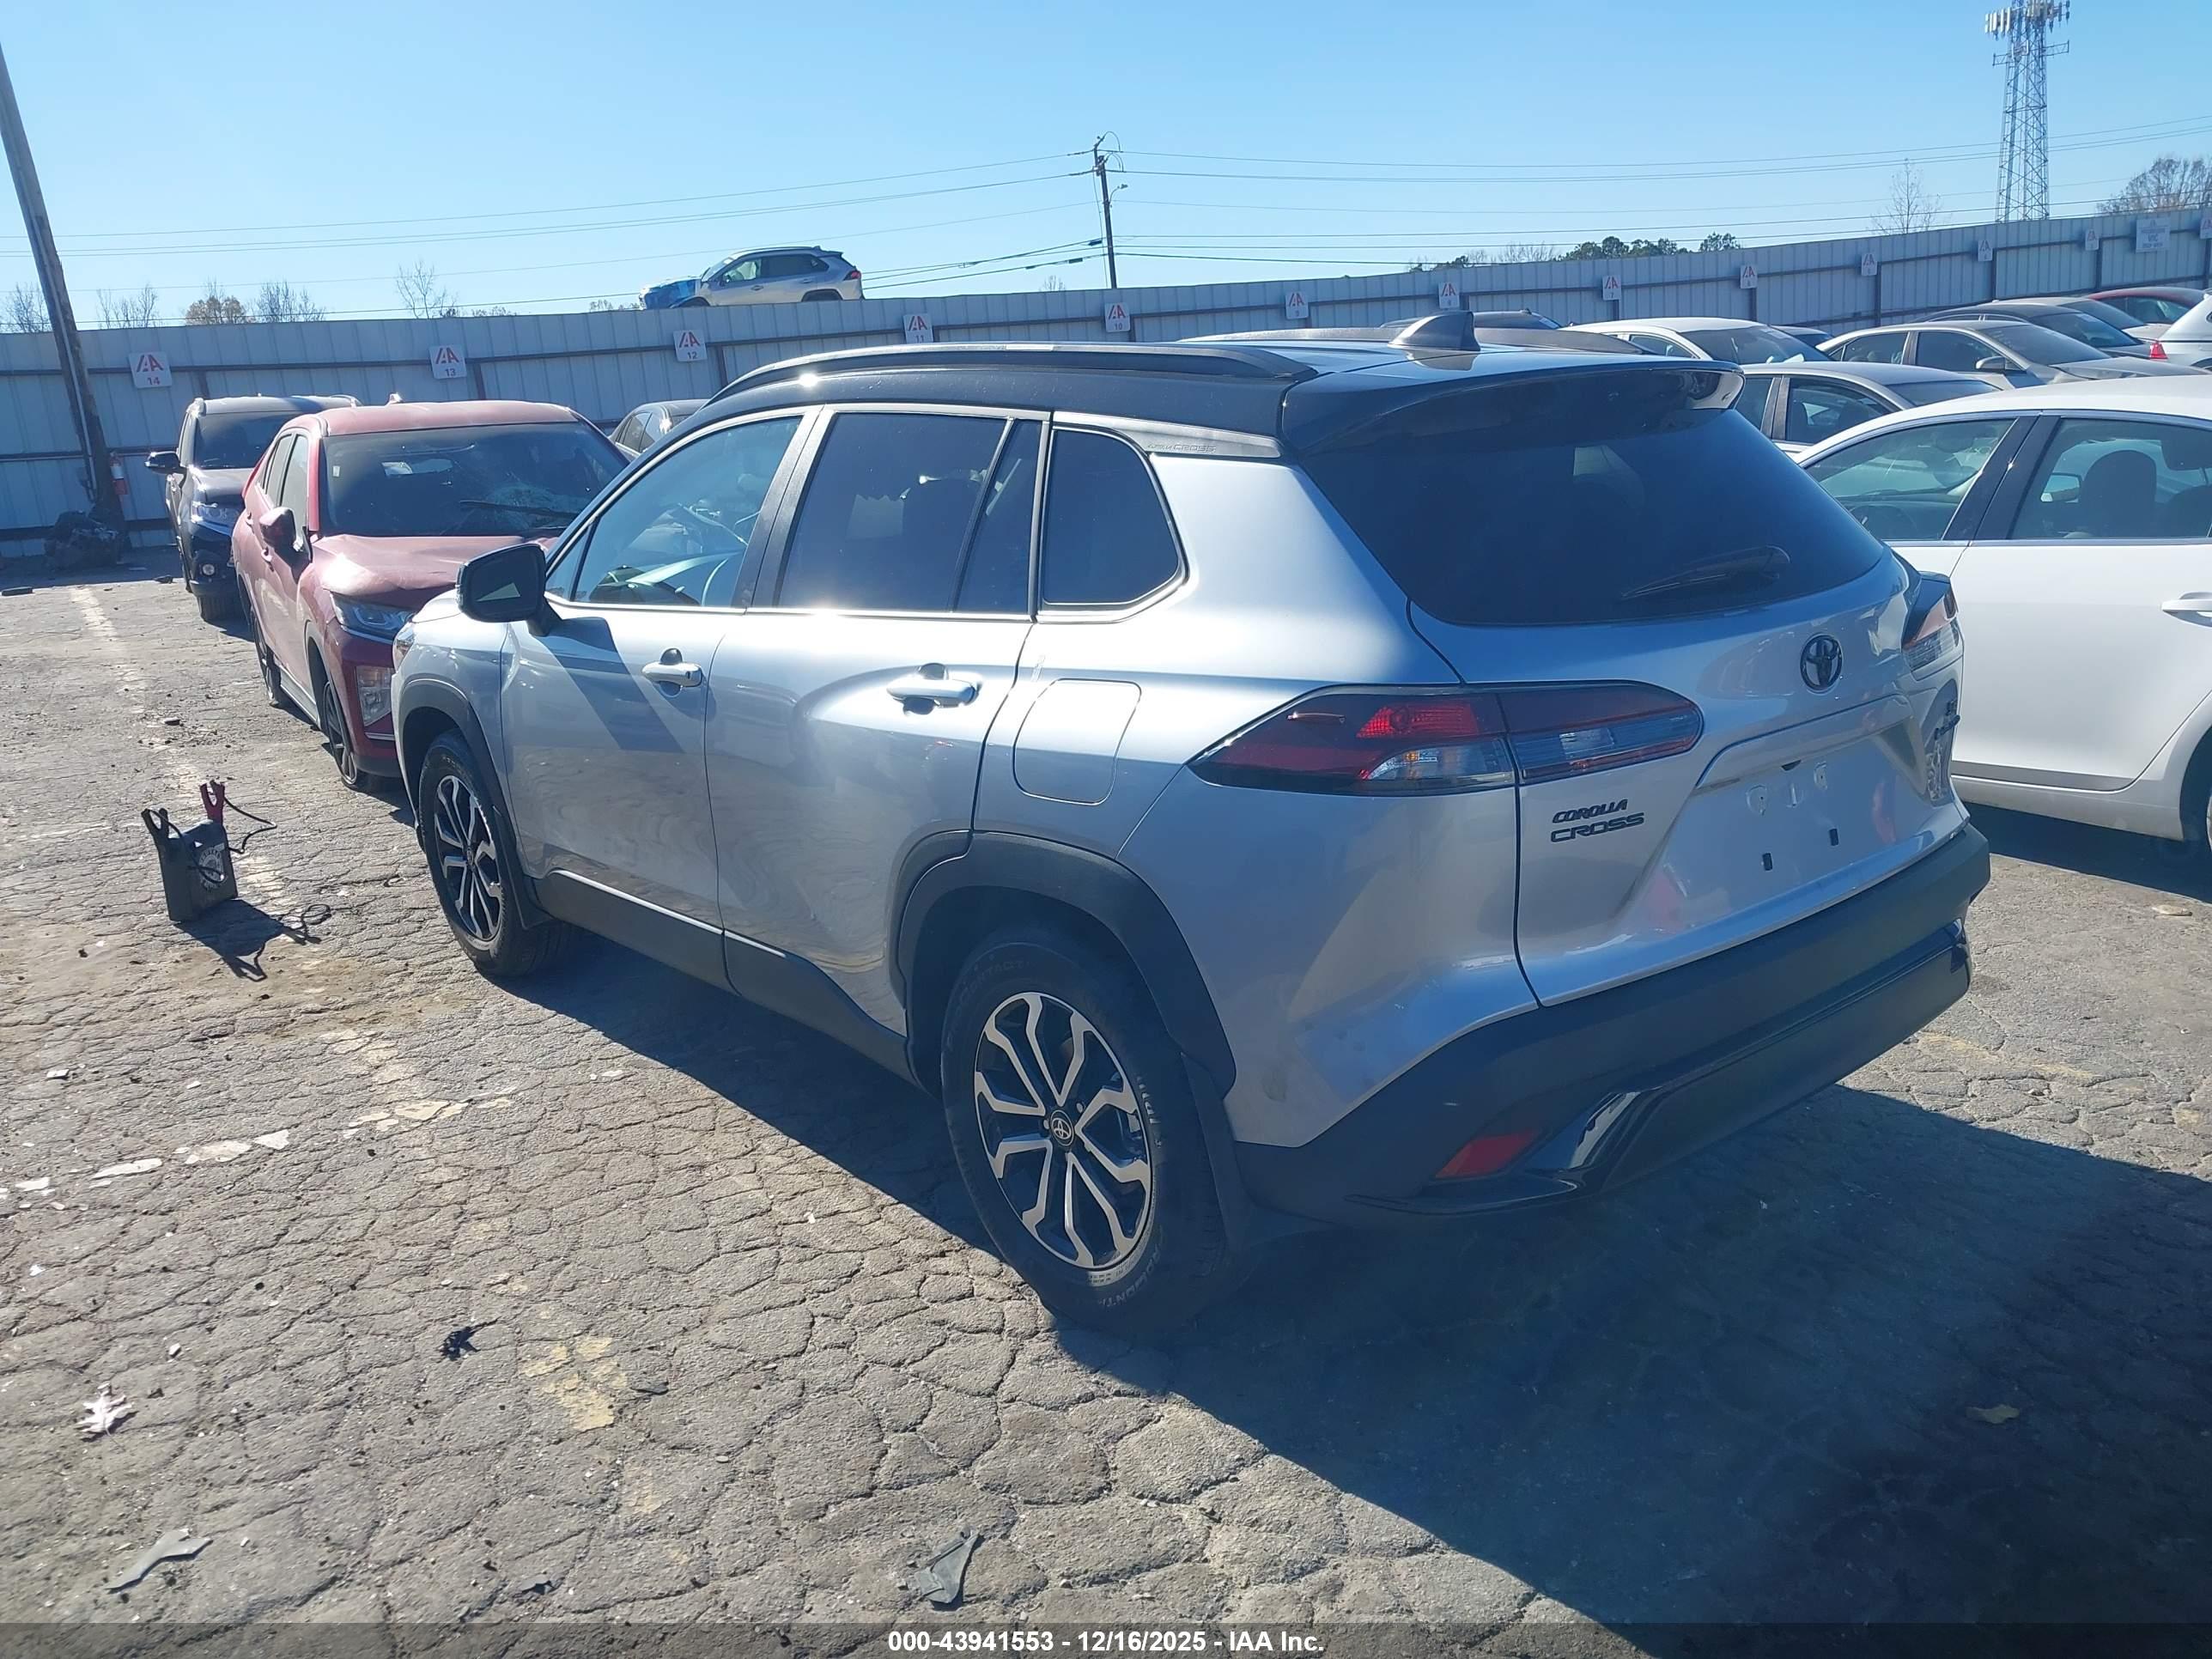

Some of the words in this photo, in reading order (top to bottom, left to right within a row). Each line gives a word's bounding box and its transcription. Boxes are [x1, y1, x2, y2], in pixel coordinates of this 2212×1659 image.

[1115, 322, 1123, 331] 10
[915, 335, 925, 344] 11
[687, 351, 697, 360] 12
[445, 368, 456, 378] 13
[147, 375, 161, 386] 14
[1552, 798, 1629, 824] COROLLA
[1550, 811, 1645, 843] CROSS
